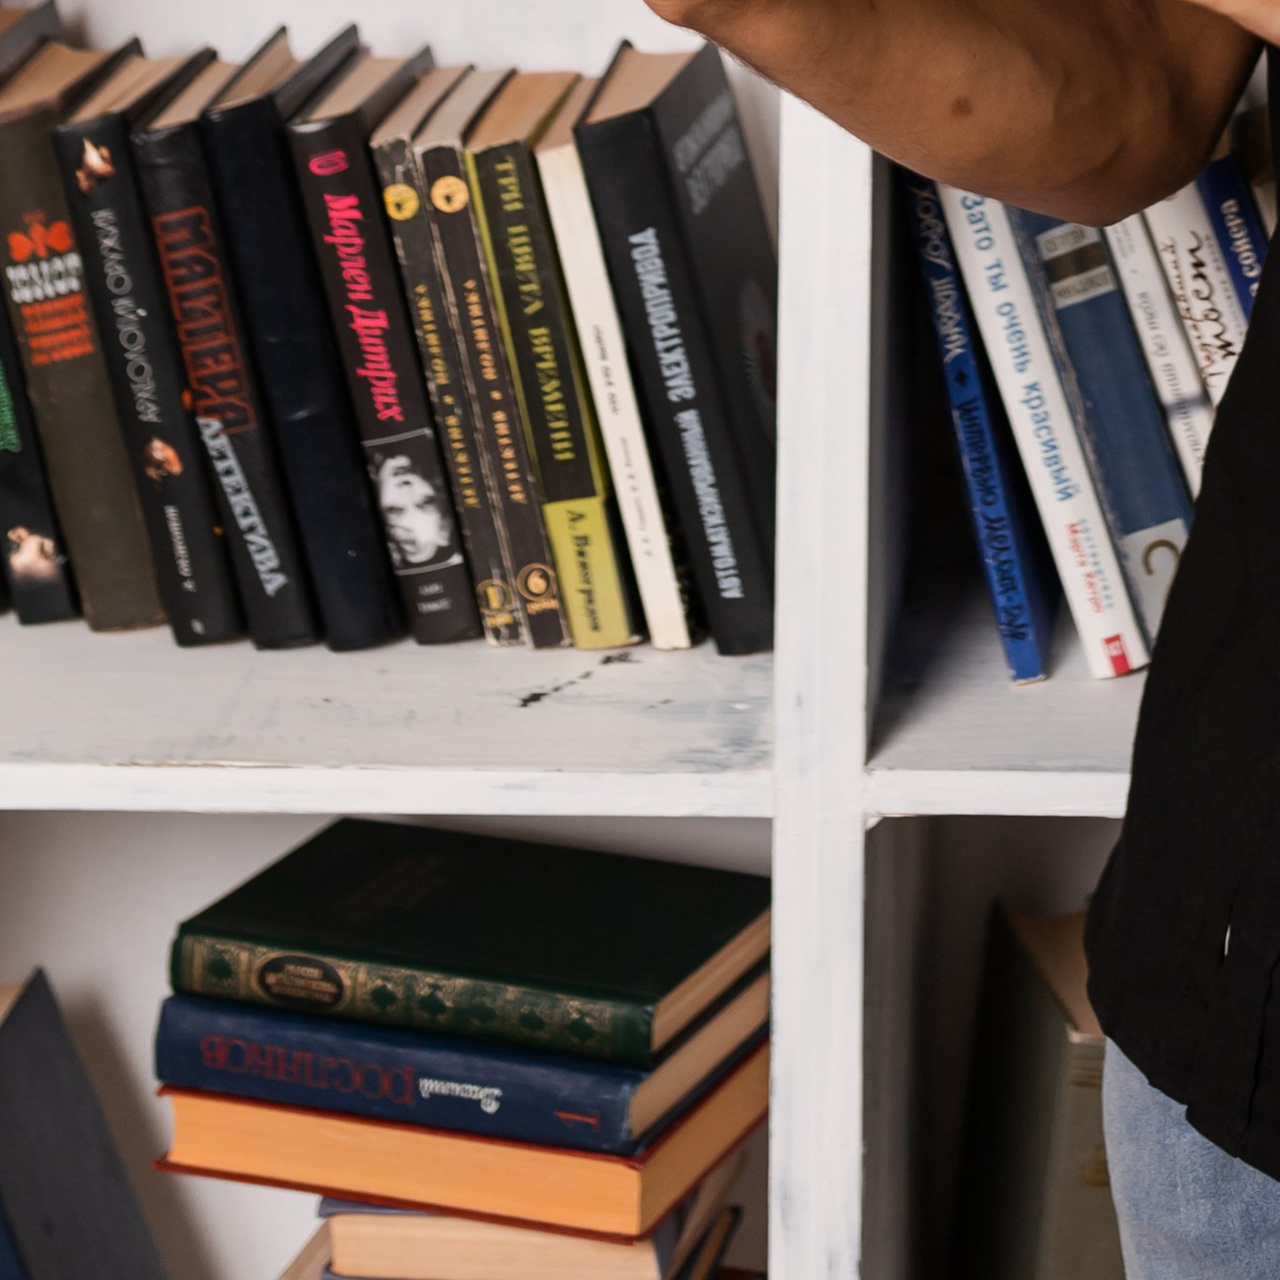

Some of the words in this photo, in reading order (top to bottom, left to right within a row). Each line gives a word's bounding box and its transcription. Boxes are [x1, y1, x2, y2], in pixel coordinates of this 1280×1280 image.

[322, 193, 373, 306] Марлен
[495, 155, 525, 213] ТРИ
[508, 221, 546, 317] ЦВЕТА
[627, 226, 698, 404] ЭЛЕКТРОПРИВОД
[346, 298, 406, 424] Дитрих
[532, 328, 576, 464] ВРЕМЕНИ
[959, 196, 995, 252] Зато
[986, 258, 1005, 292] ты
[996, 302, 1033, 376] очень
[1018, 381, 1081, 503] красивый
[673, 408, 745, 600] АВТОМАТИЗИРОВАННЫЙ
